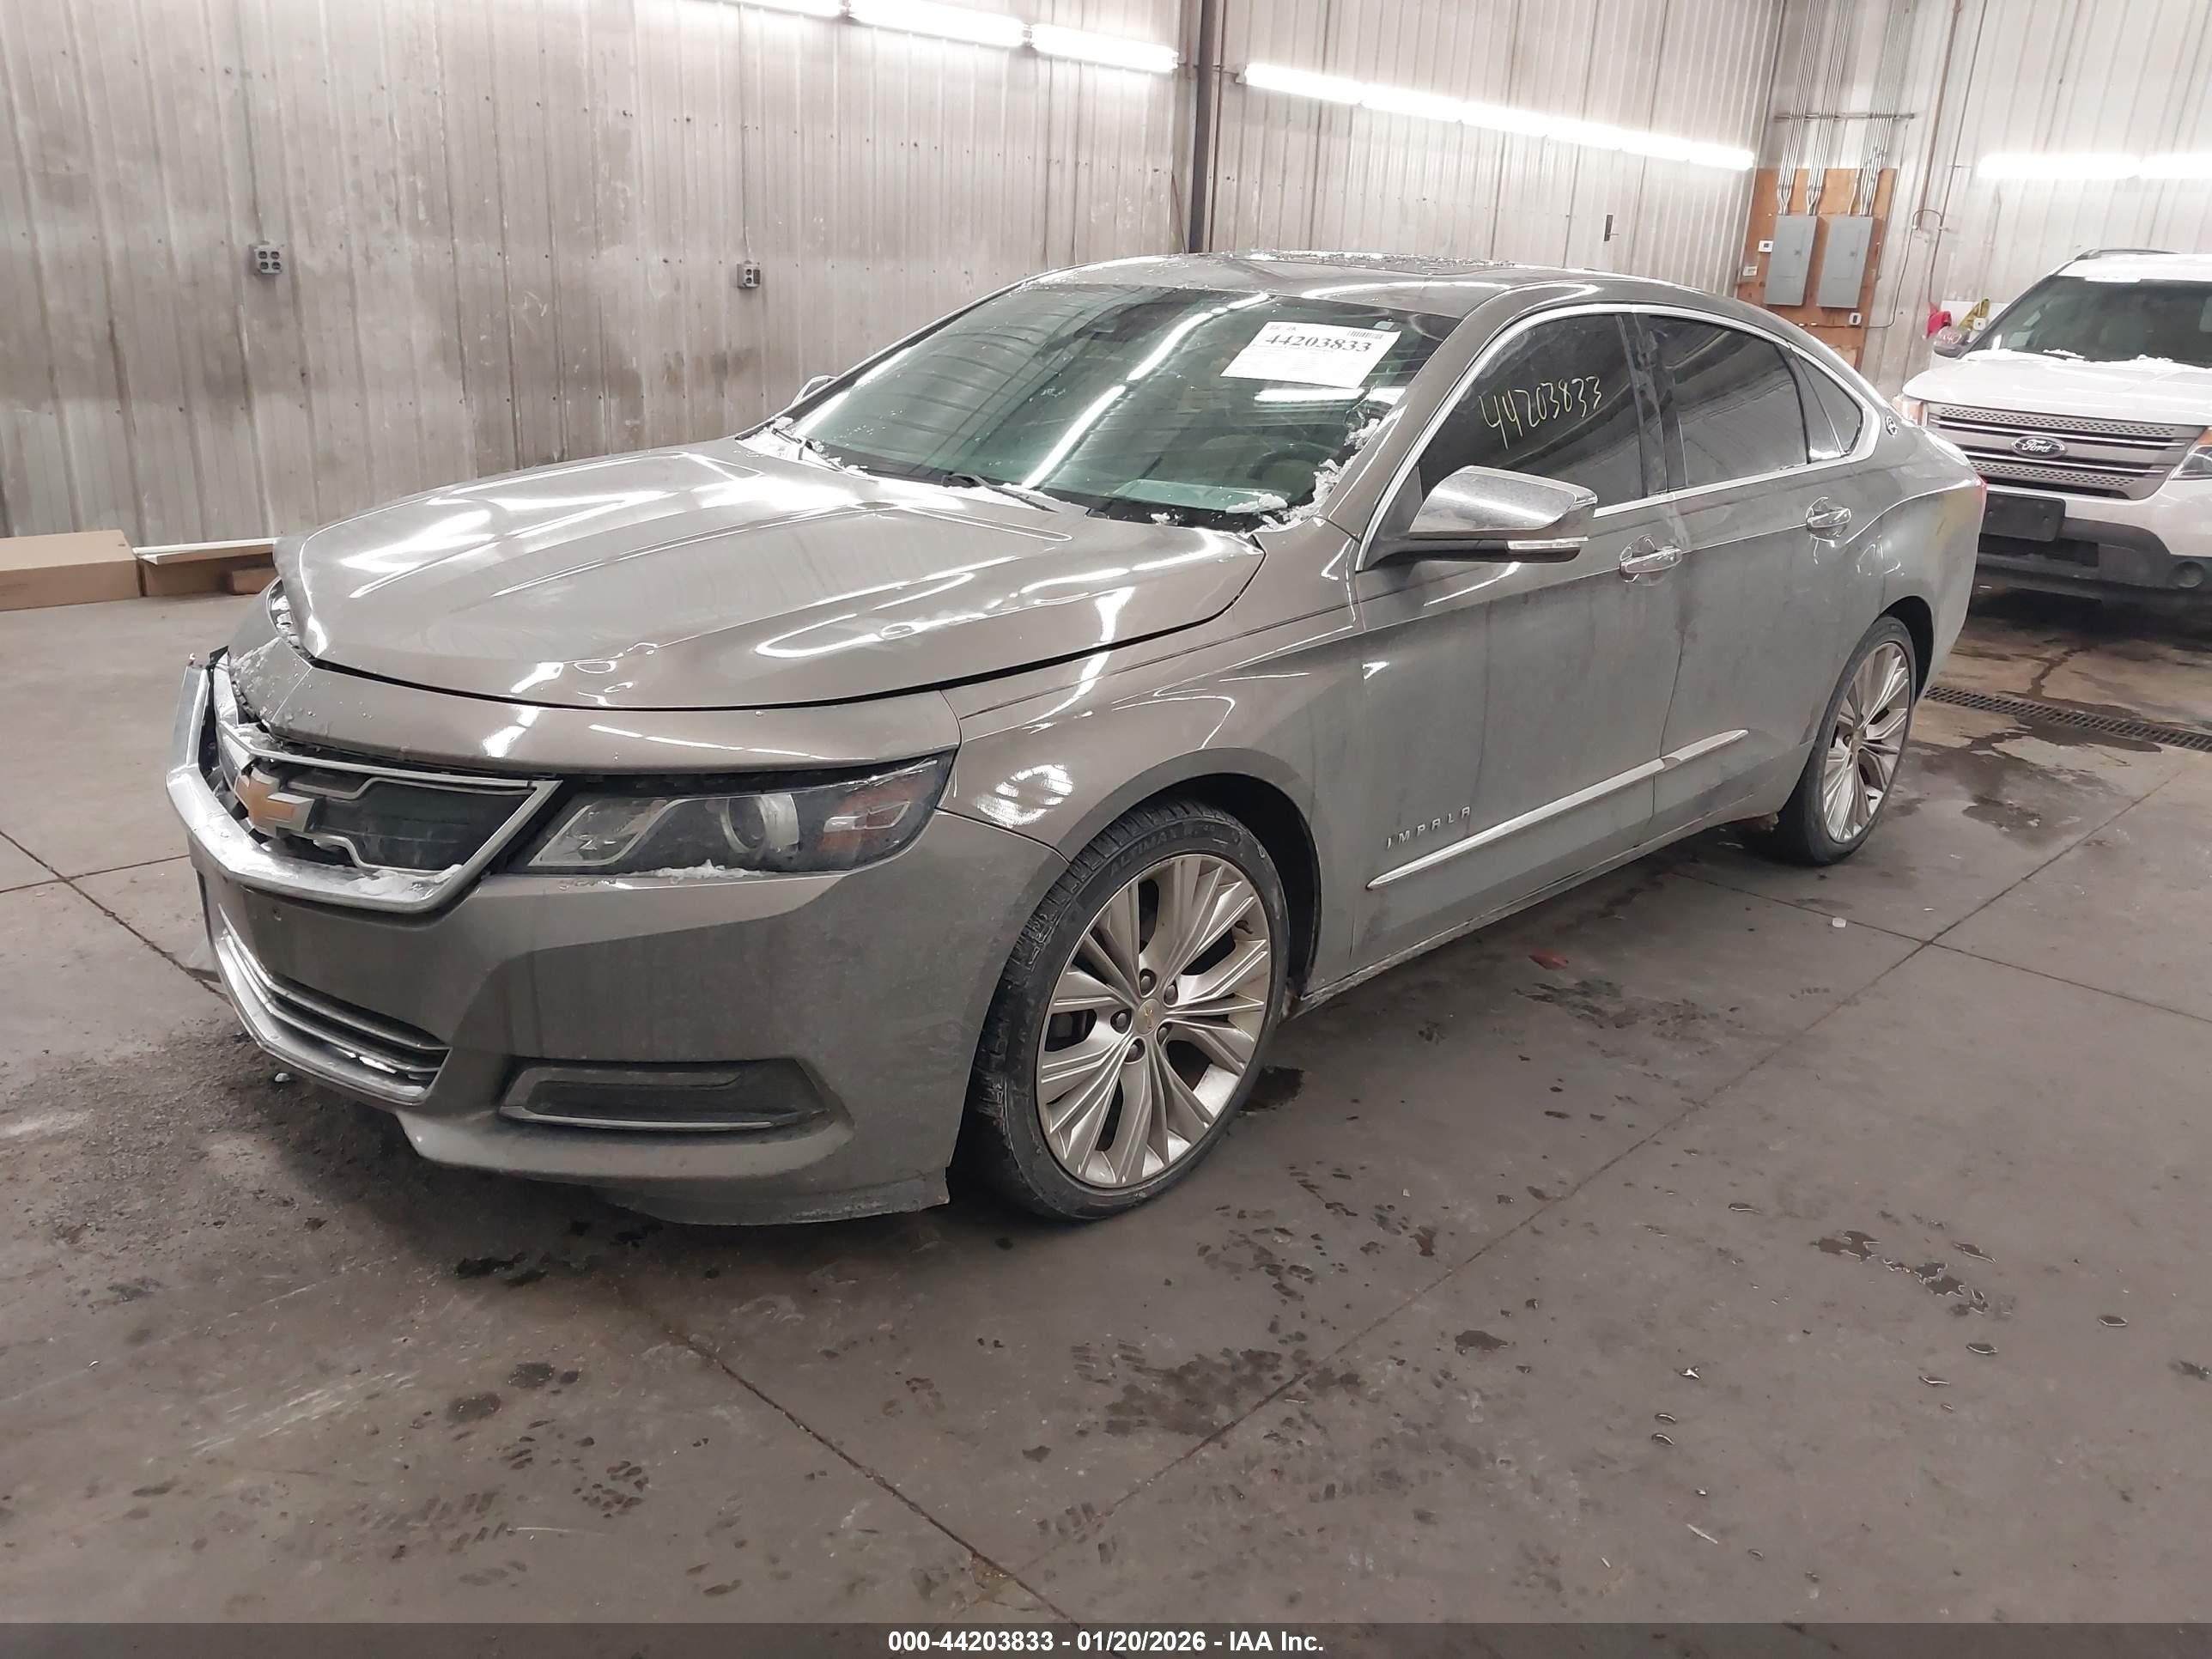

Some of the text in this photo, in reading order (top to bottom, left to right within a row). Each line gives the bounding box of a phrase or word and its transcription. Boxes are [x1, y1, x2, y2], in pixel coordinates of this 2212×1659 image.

[1265, 334, 1371, 352] 44203833
[1478, 376, 1601, 449] 44203833
[2022, 439, 2052, 453] Ford
[1387, 806, 1470, 849] IMPALA
